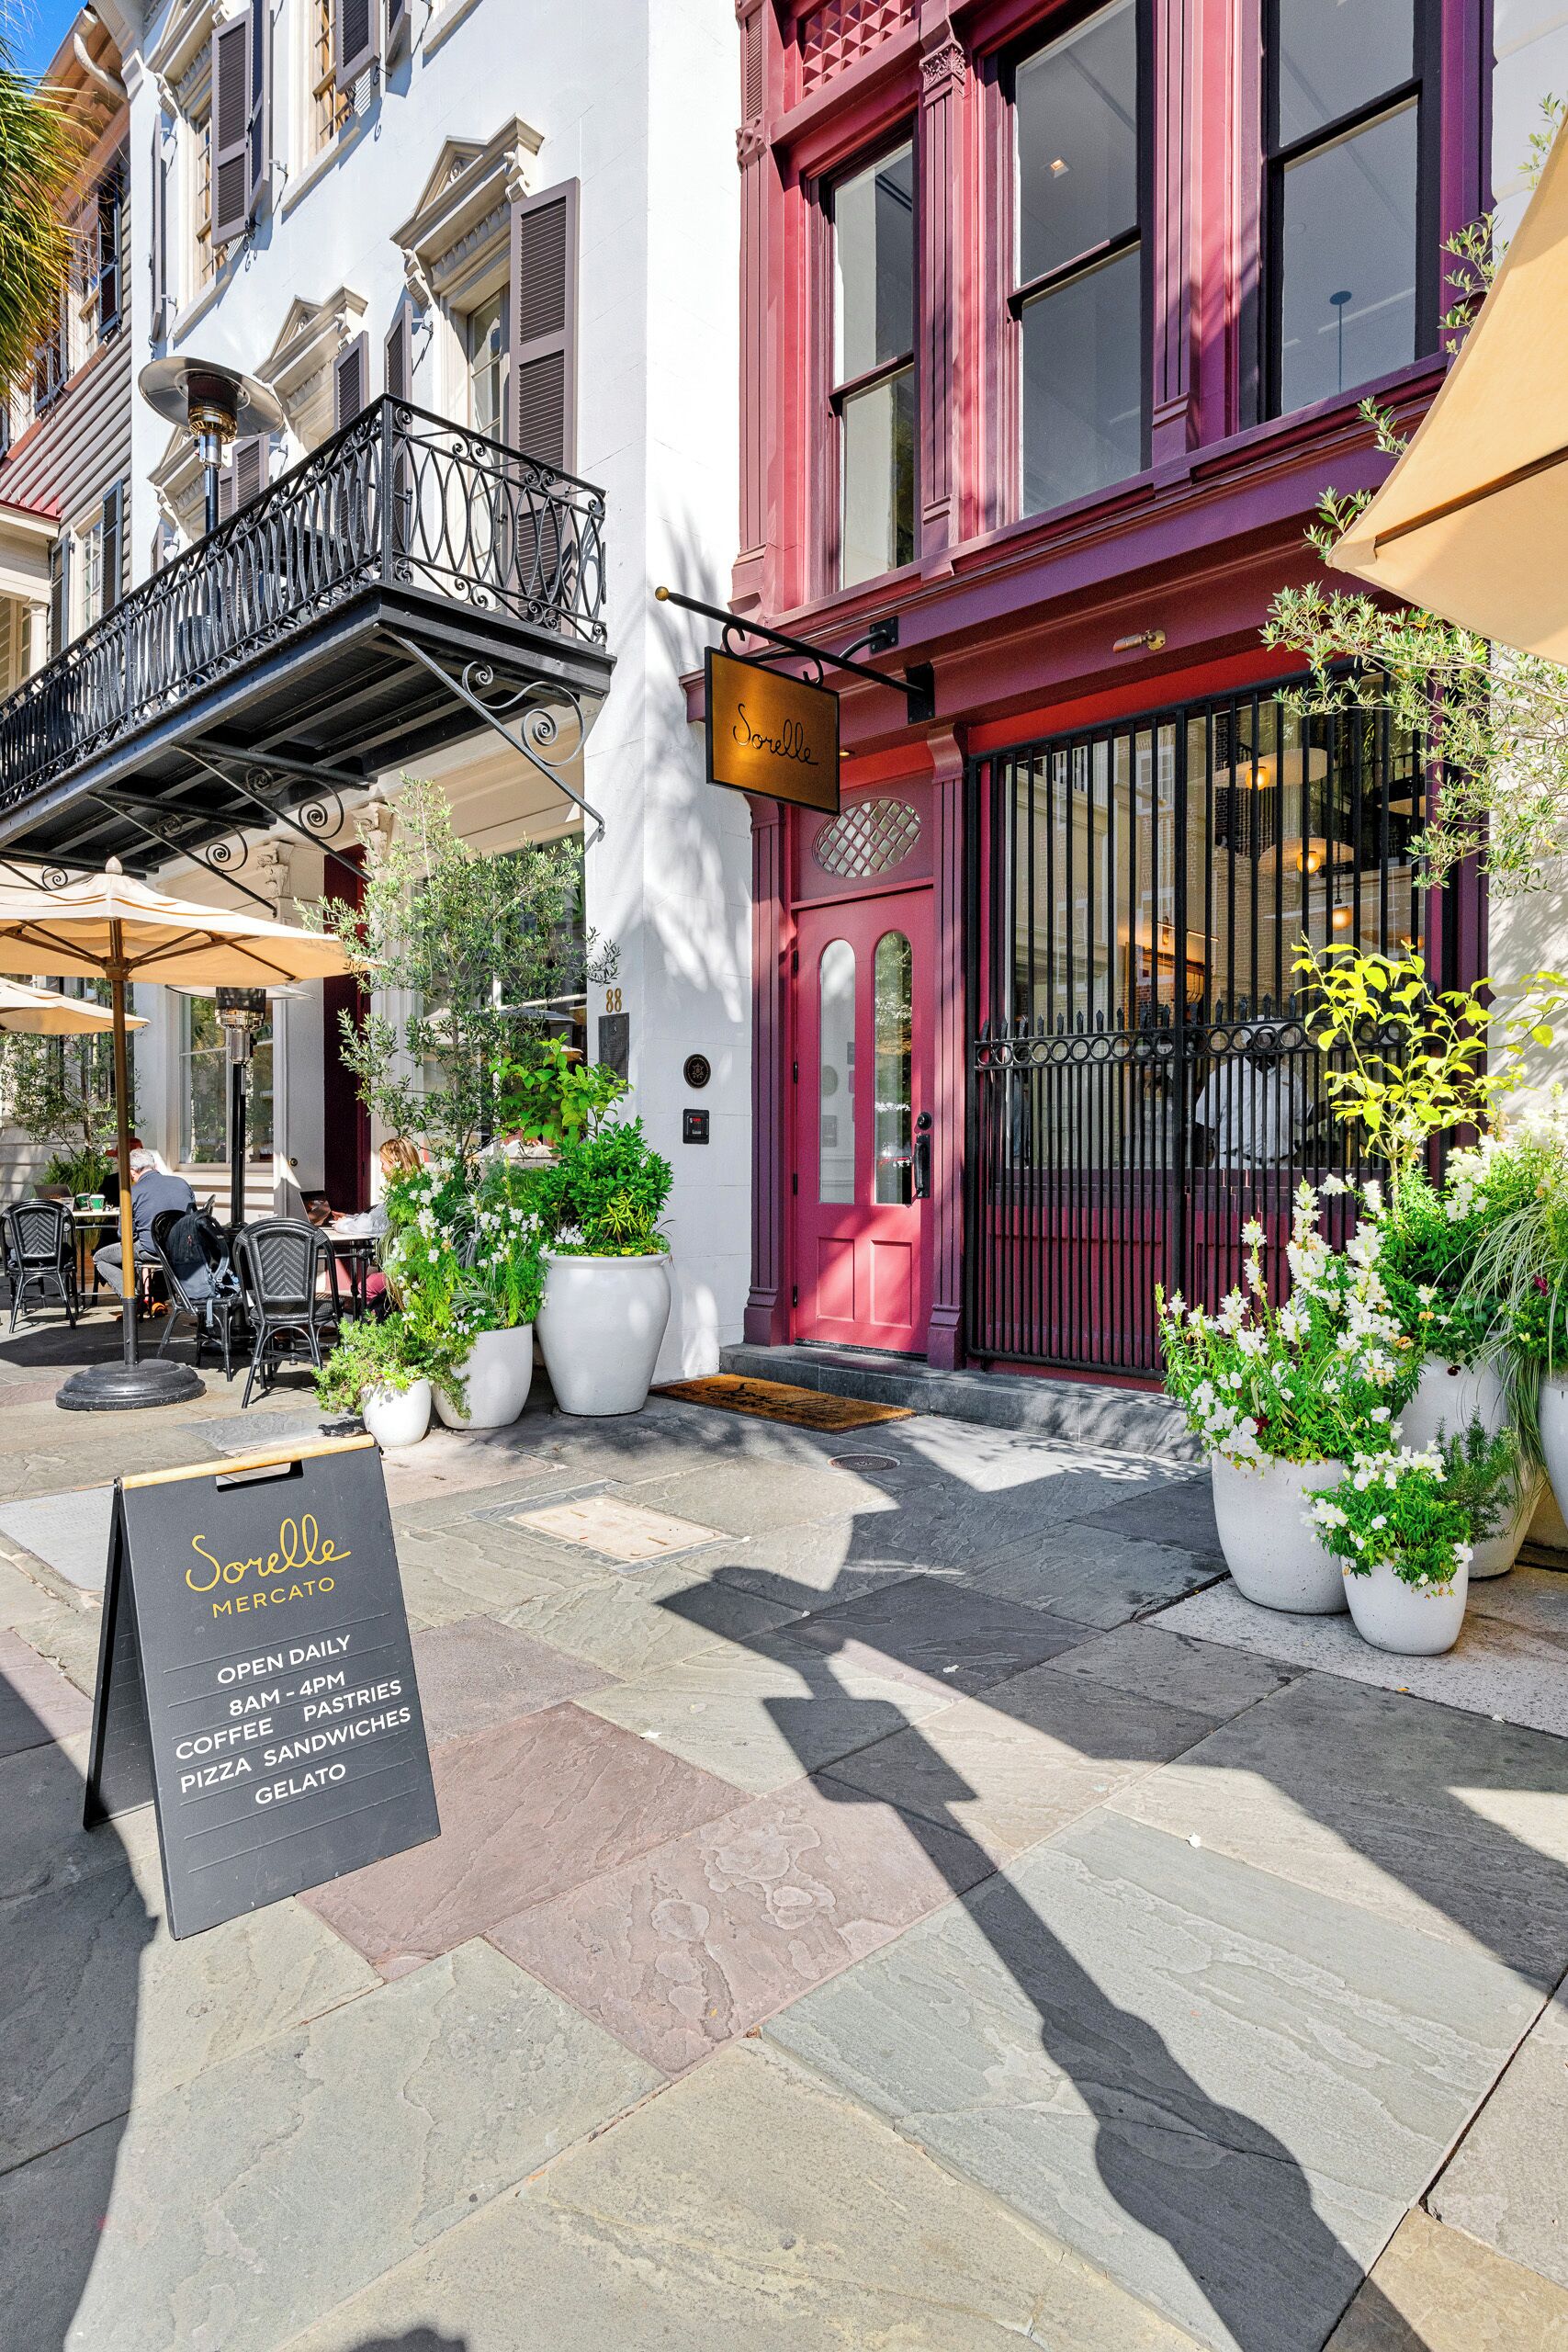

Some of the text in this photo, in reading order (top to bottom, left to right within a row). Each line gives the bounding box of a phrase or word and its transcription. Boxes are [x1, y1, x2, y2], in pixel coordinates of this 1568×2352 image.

[733, 703, 819, 765] Sorelle
[606, 988, 622, 1013] 88
[186, 1514, 351, 1592] Sorelle
[212, 1577, 335, 1618] MERCATO
[217, 1634, 351, 1684] OPEN DAILY
[229, 1689, 280, 1716] 8AM
[299, 1670, 345, 1696] 4PM
[175, 1679, 402, 1760] COFFEE PASTRIES
[181, 1707, 412, 1794] PIZZA SANDWICHES
[254, 1763, 346, 1804] GELATO
